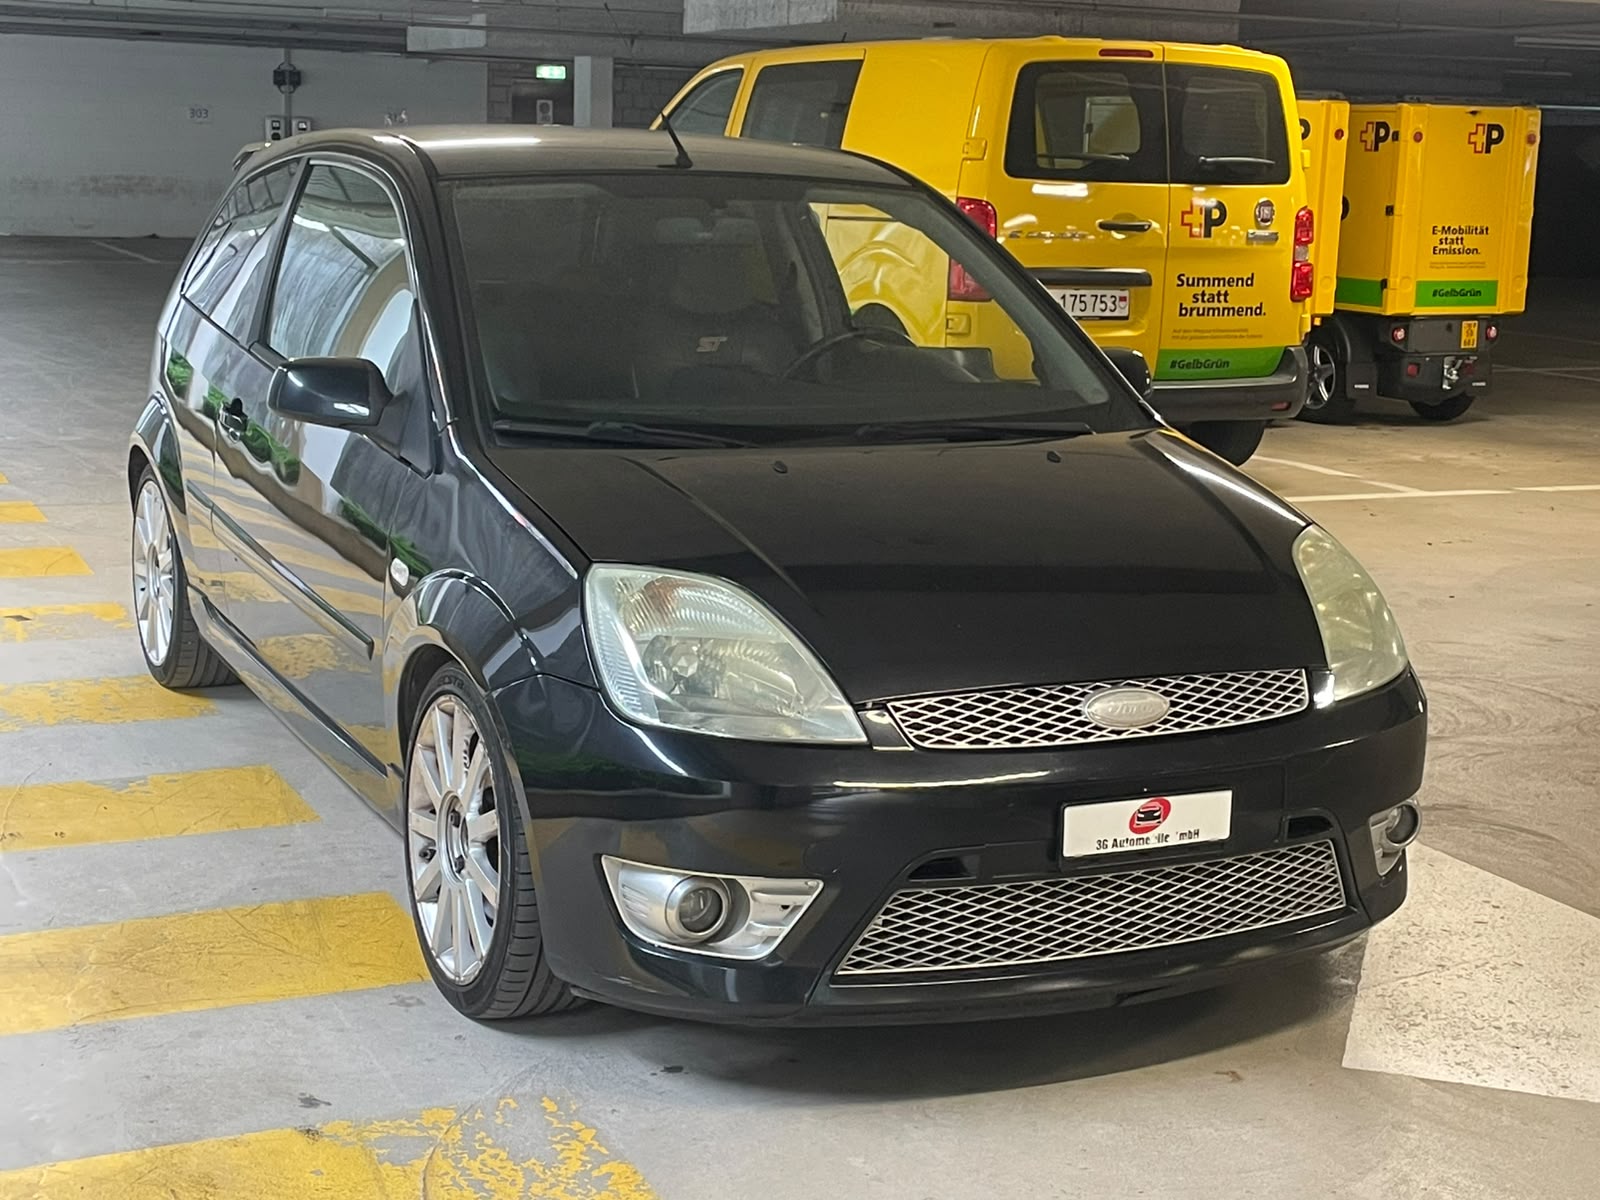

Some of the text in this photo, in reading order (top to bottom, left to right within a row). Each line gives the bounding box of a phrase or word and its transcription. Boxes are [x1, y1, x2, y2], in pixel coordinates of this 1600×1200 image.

[1431, 225, 1489, 236] E-Mobilität
[1438, 236, 1464, 246] statt
[1432, 245, 1481, 256] Emission.
[1176, 272, 1255, 287] Summend
[1191, 289, 1230, 304] statt
[1431, 288, 1482, 298] #GelbGrün
[1178, 301, 1267, 317] brummend.
[1169, 357, 1230, 370] #GelbGrün
[1175, 828, 1200, 841] mbH
